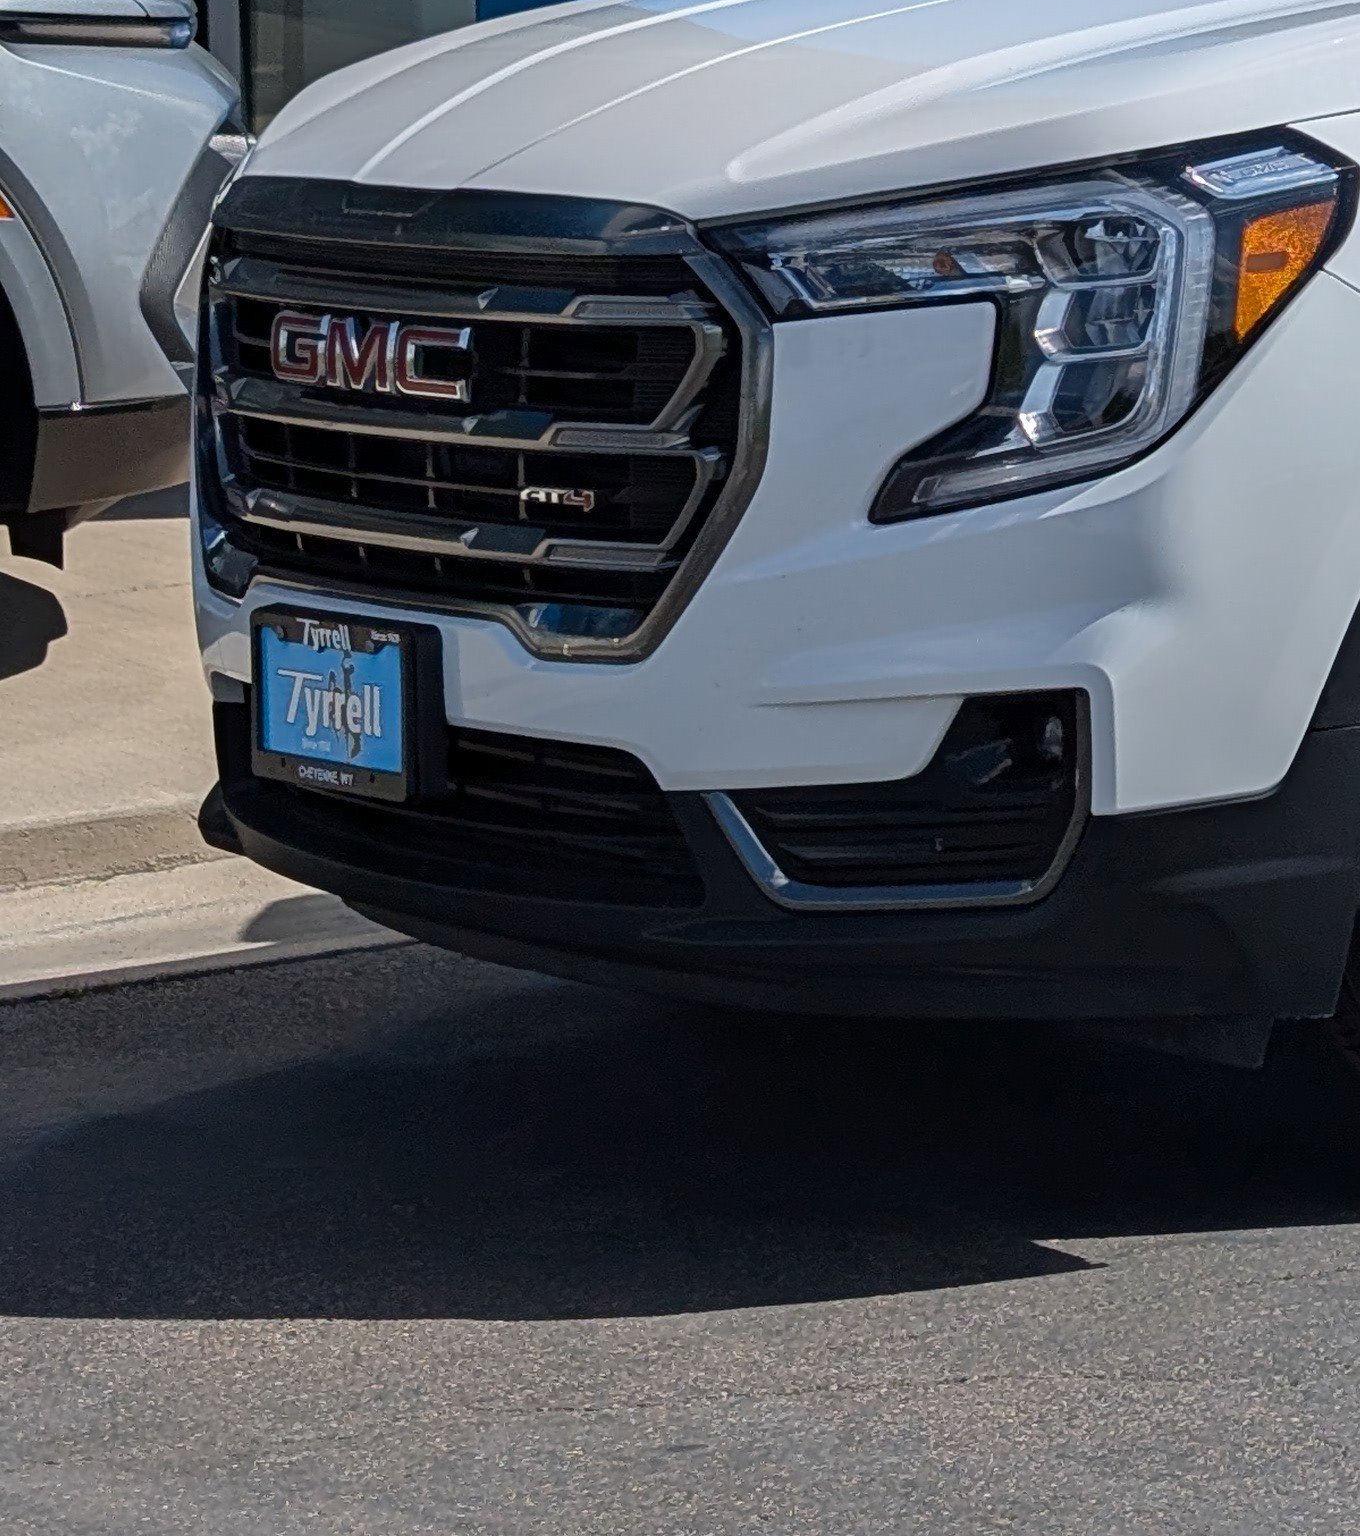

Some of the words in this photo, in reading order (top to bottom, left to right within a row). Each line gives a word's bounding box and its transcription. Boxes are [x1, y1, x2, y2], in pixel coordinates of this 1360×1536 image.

[270, 310, 473, 404] GMC
[518, 486, 596, 513] AT4
[296, 618, 351, 652] Tyrrell
[277, 668, 381, 737] Tyrrell
